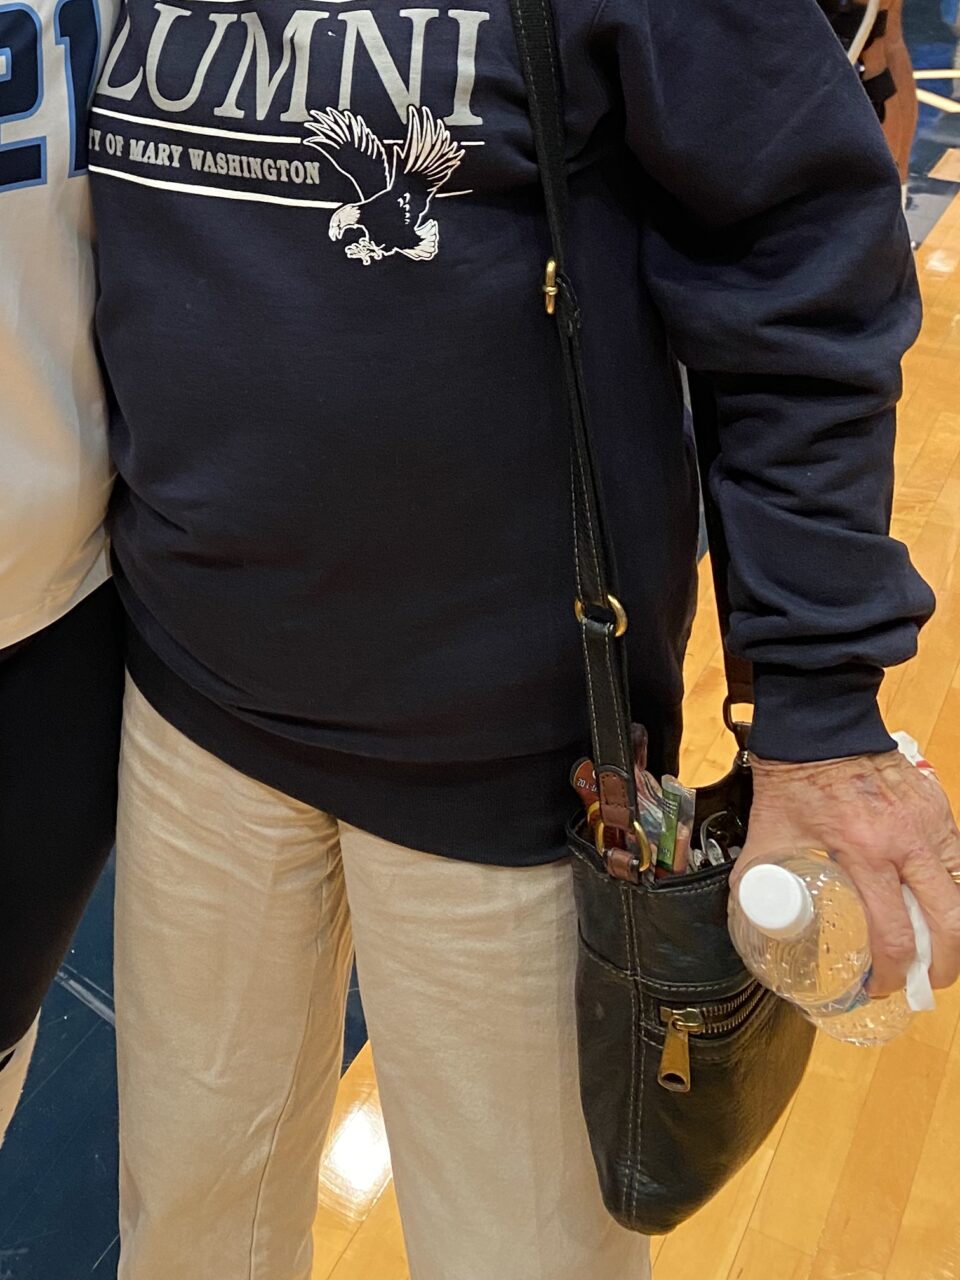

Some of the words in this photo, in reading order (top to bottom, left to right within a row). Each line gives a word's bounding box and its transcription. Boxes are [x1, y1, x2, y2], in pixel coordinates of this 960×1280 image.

[105, 132, 125, 157] OF
[129, 138, 184, 168] MARY
[188, 147, 321, 185] WASHINGTON
